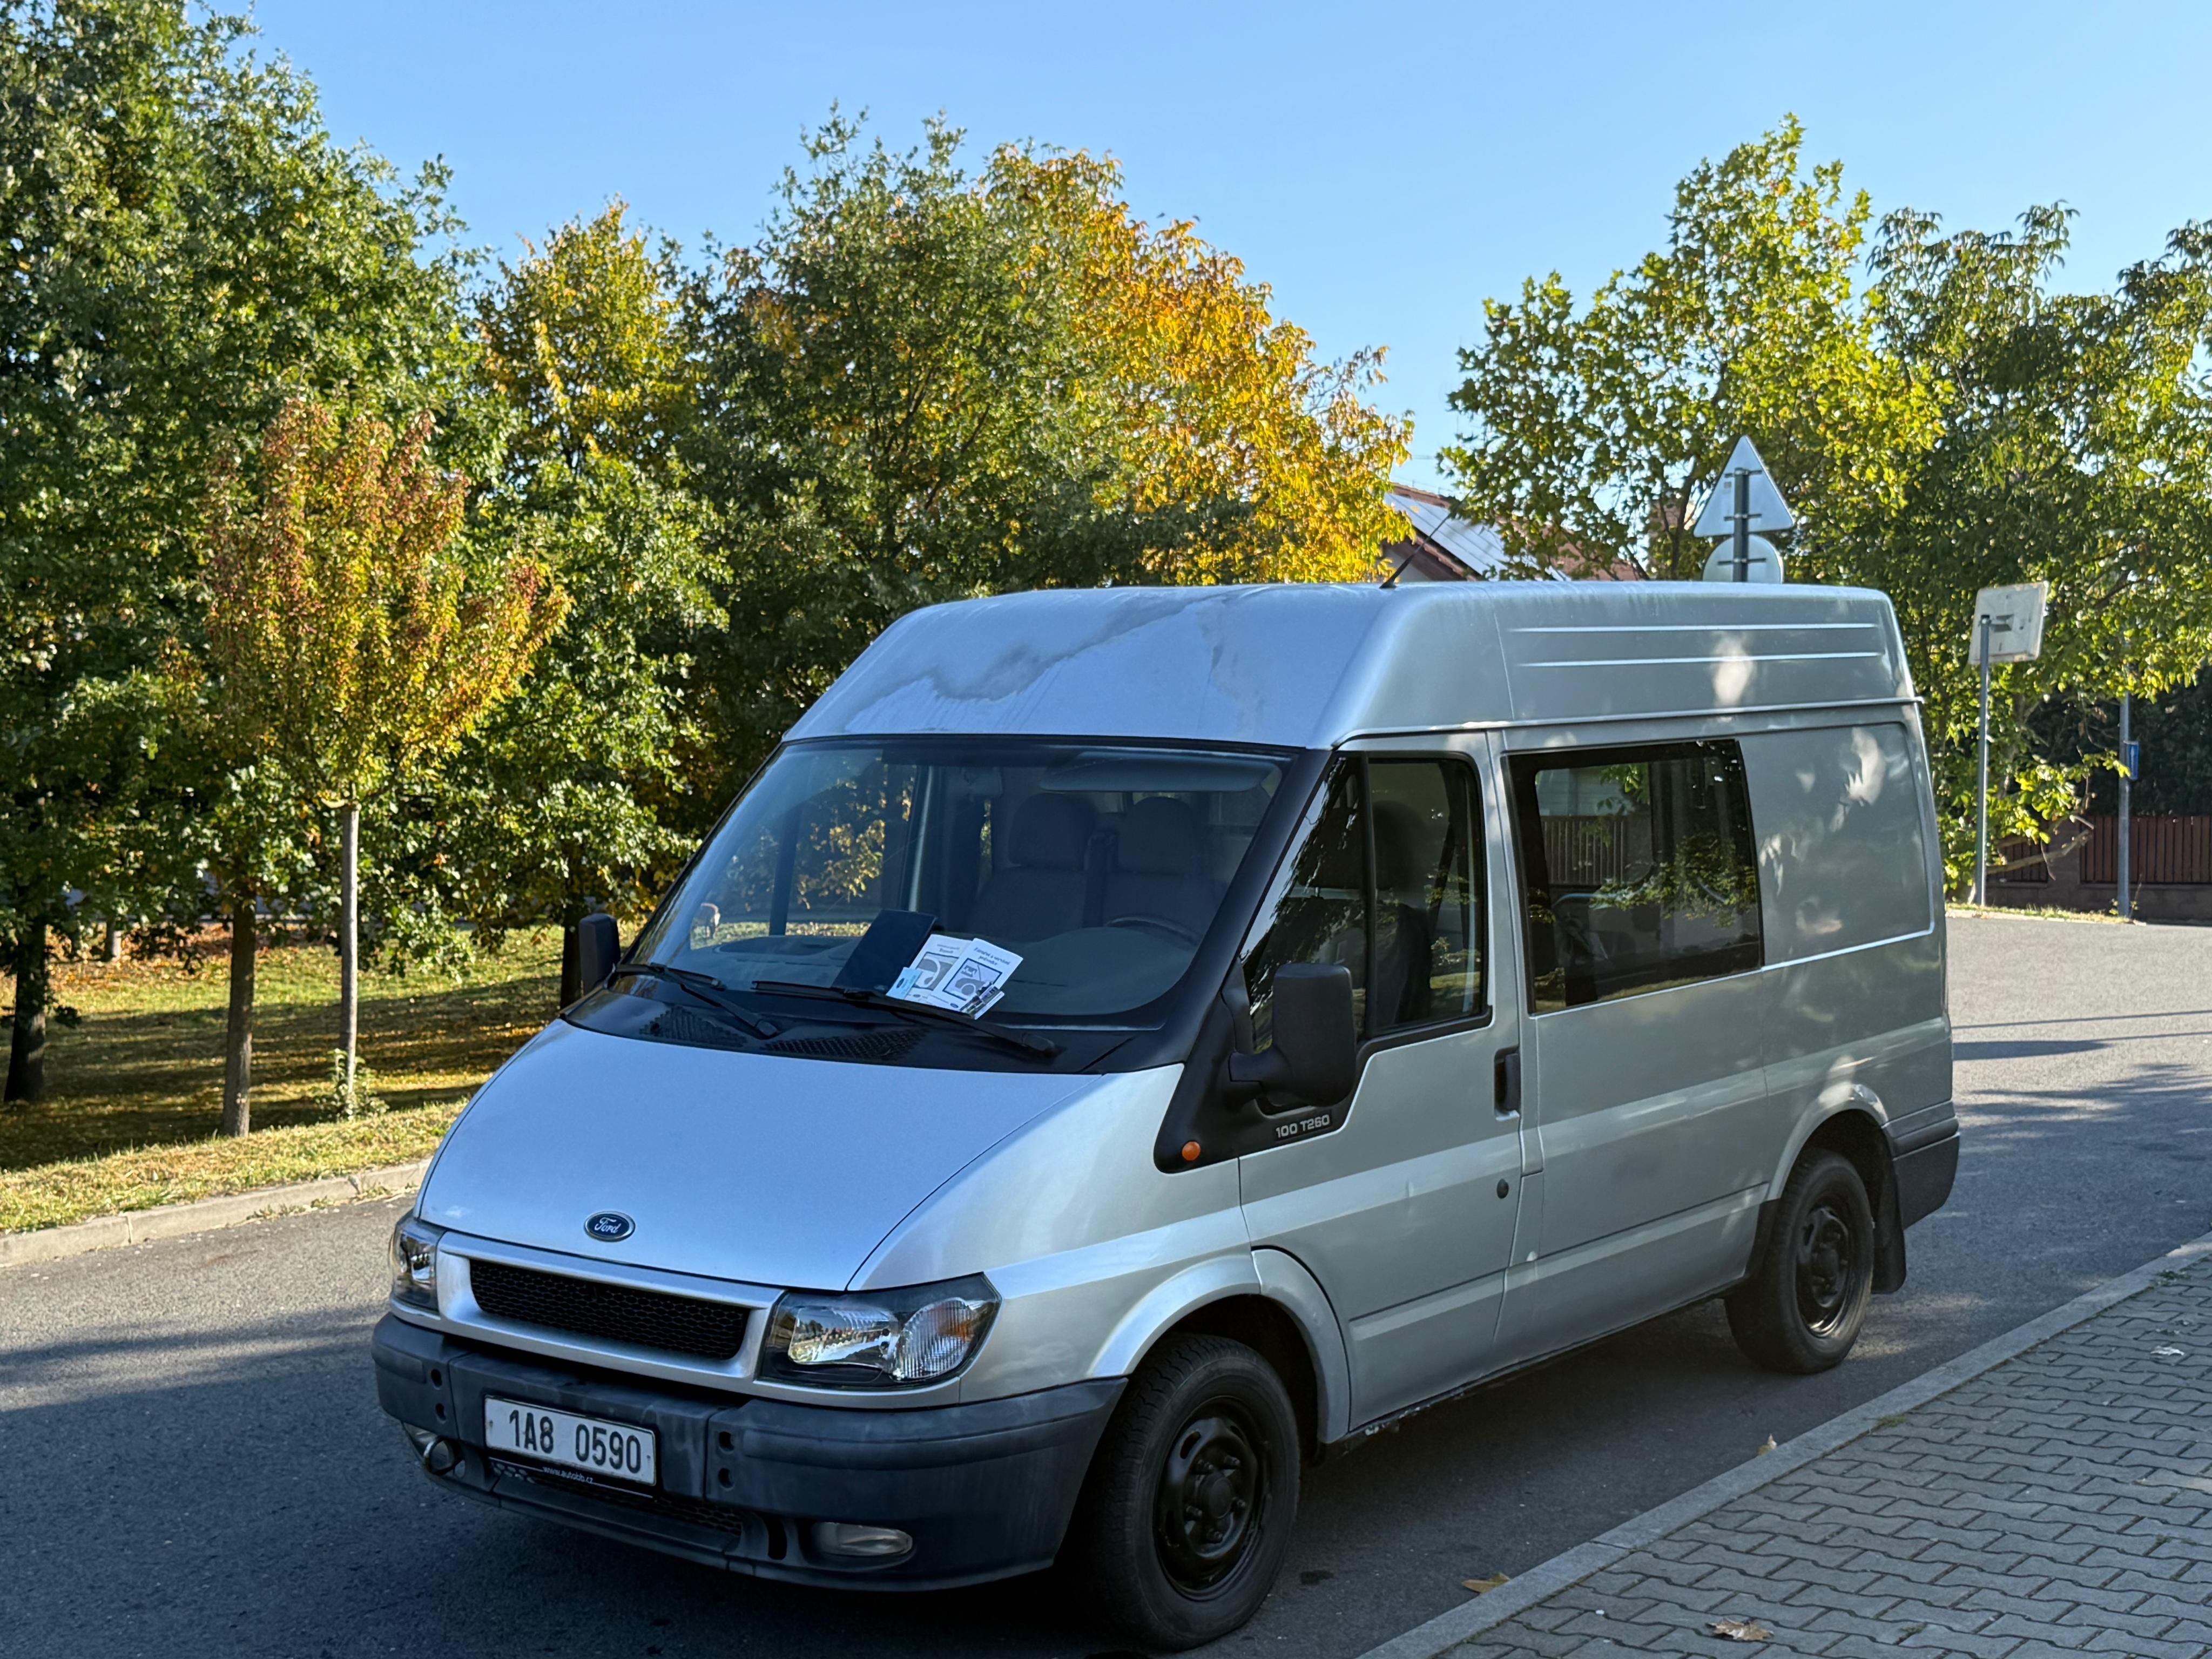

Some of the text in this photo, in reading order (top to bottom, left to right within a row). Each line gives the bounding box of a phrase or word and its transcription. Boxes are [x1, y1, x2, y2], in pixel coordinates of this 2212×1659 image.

[1276, 1114, 1330, 1138] 100 T260
[594, 1217, 622, 1234] Ford
[509, 1410, 642, 1474] 1A8 0590
